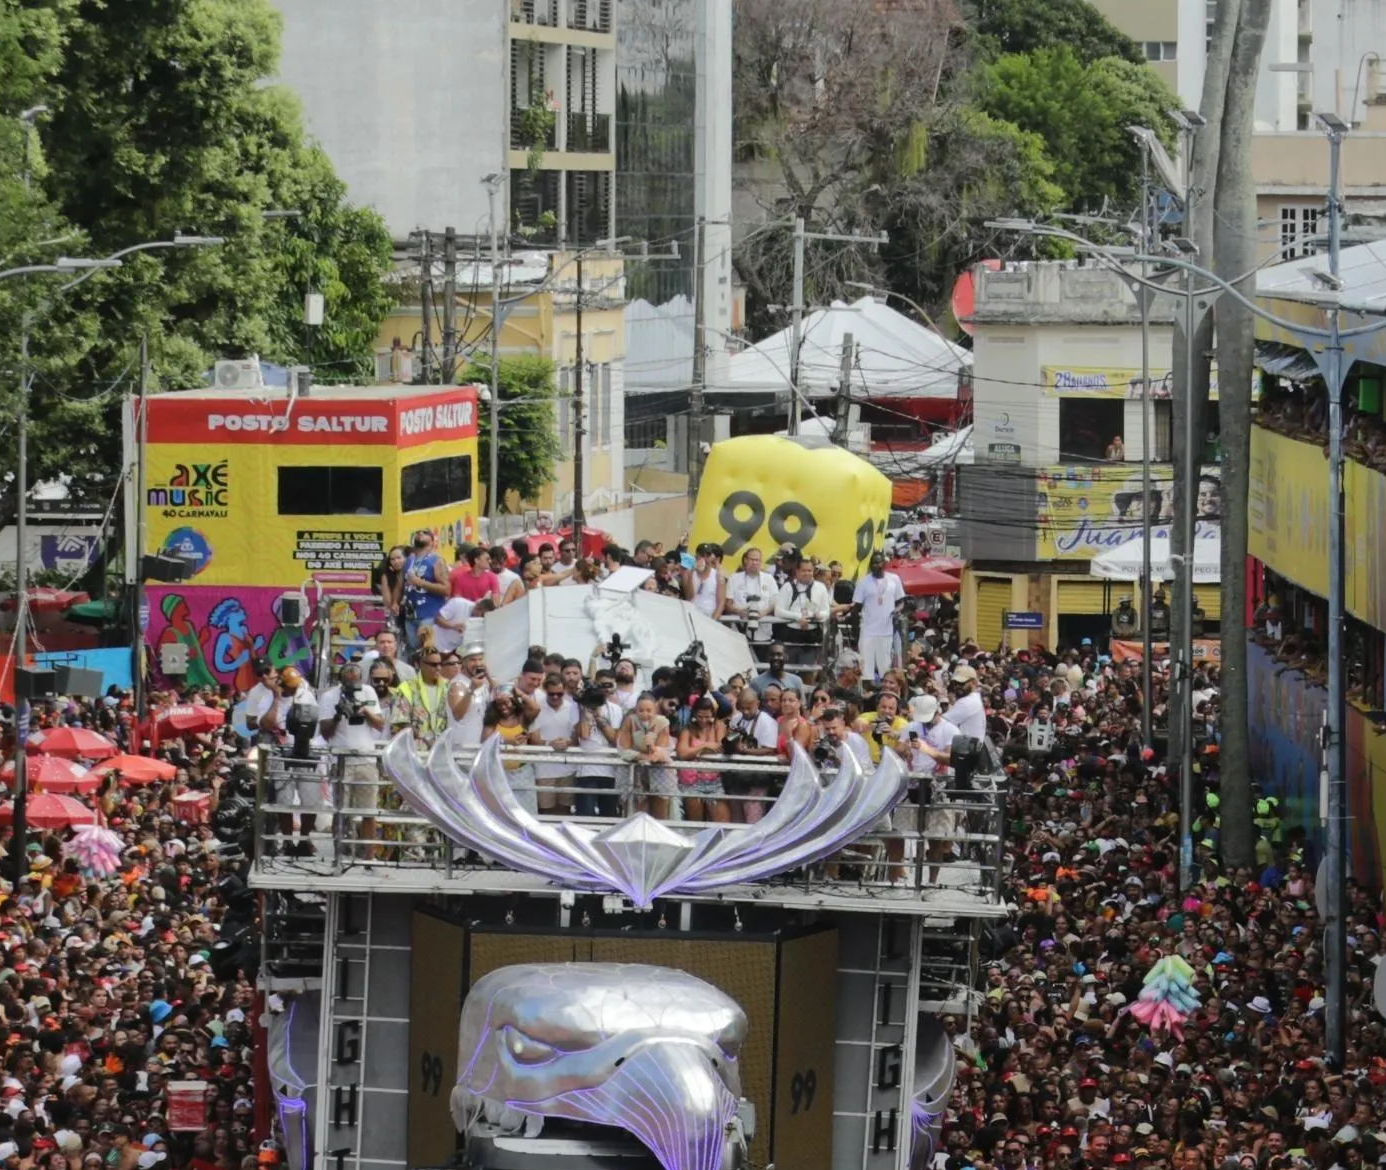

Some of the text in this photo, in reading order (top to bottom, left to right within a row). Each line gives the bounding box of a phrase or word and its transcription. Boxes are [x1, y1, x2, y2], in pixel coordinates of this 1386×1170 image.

[208, 415, 388, 433] POSTO SALTUR
[400, 402, 473, 436] POSTO SALTUR
[791, 1069, 816, 1114] 99
